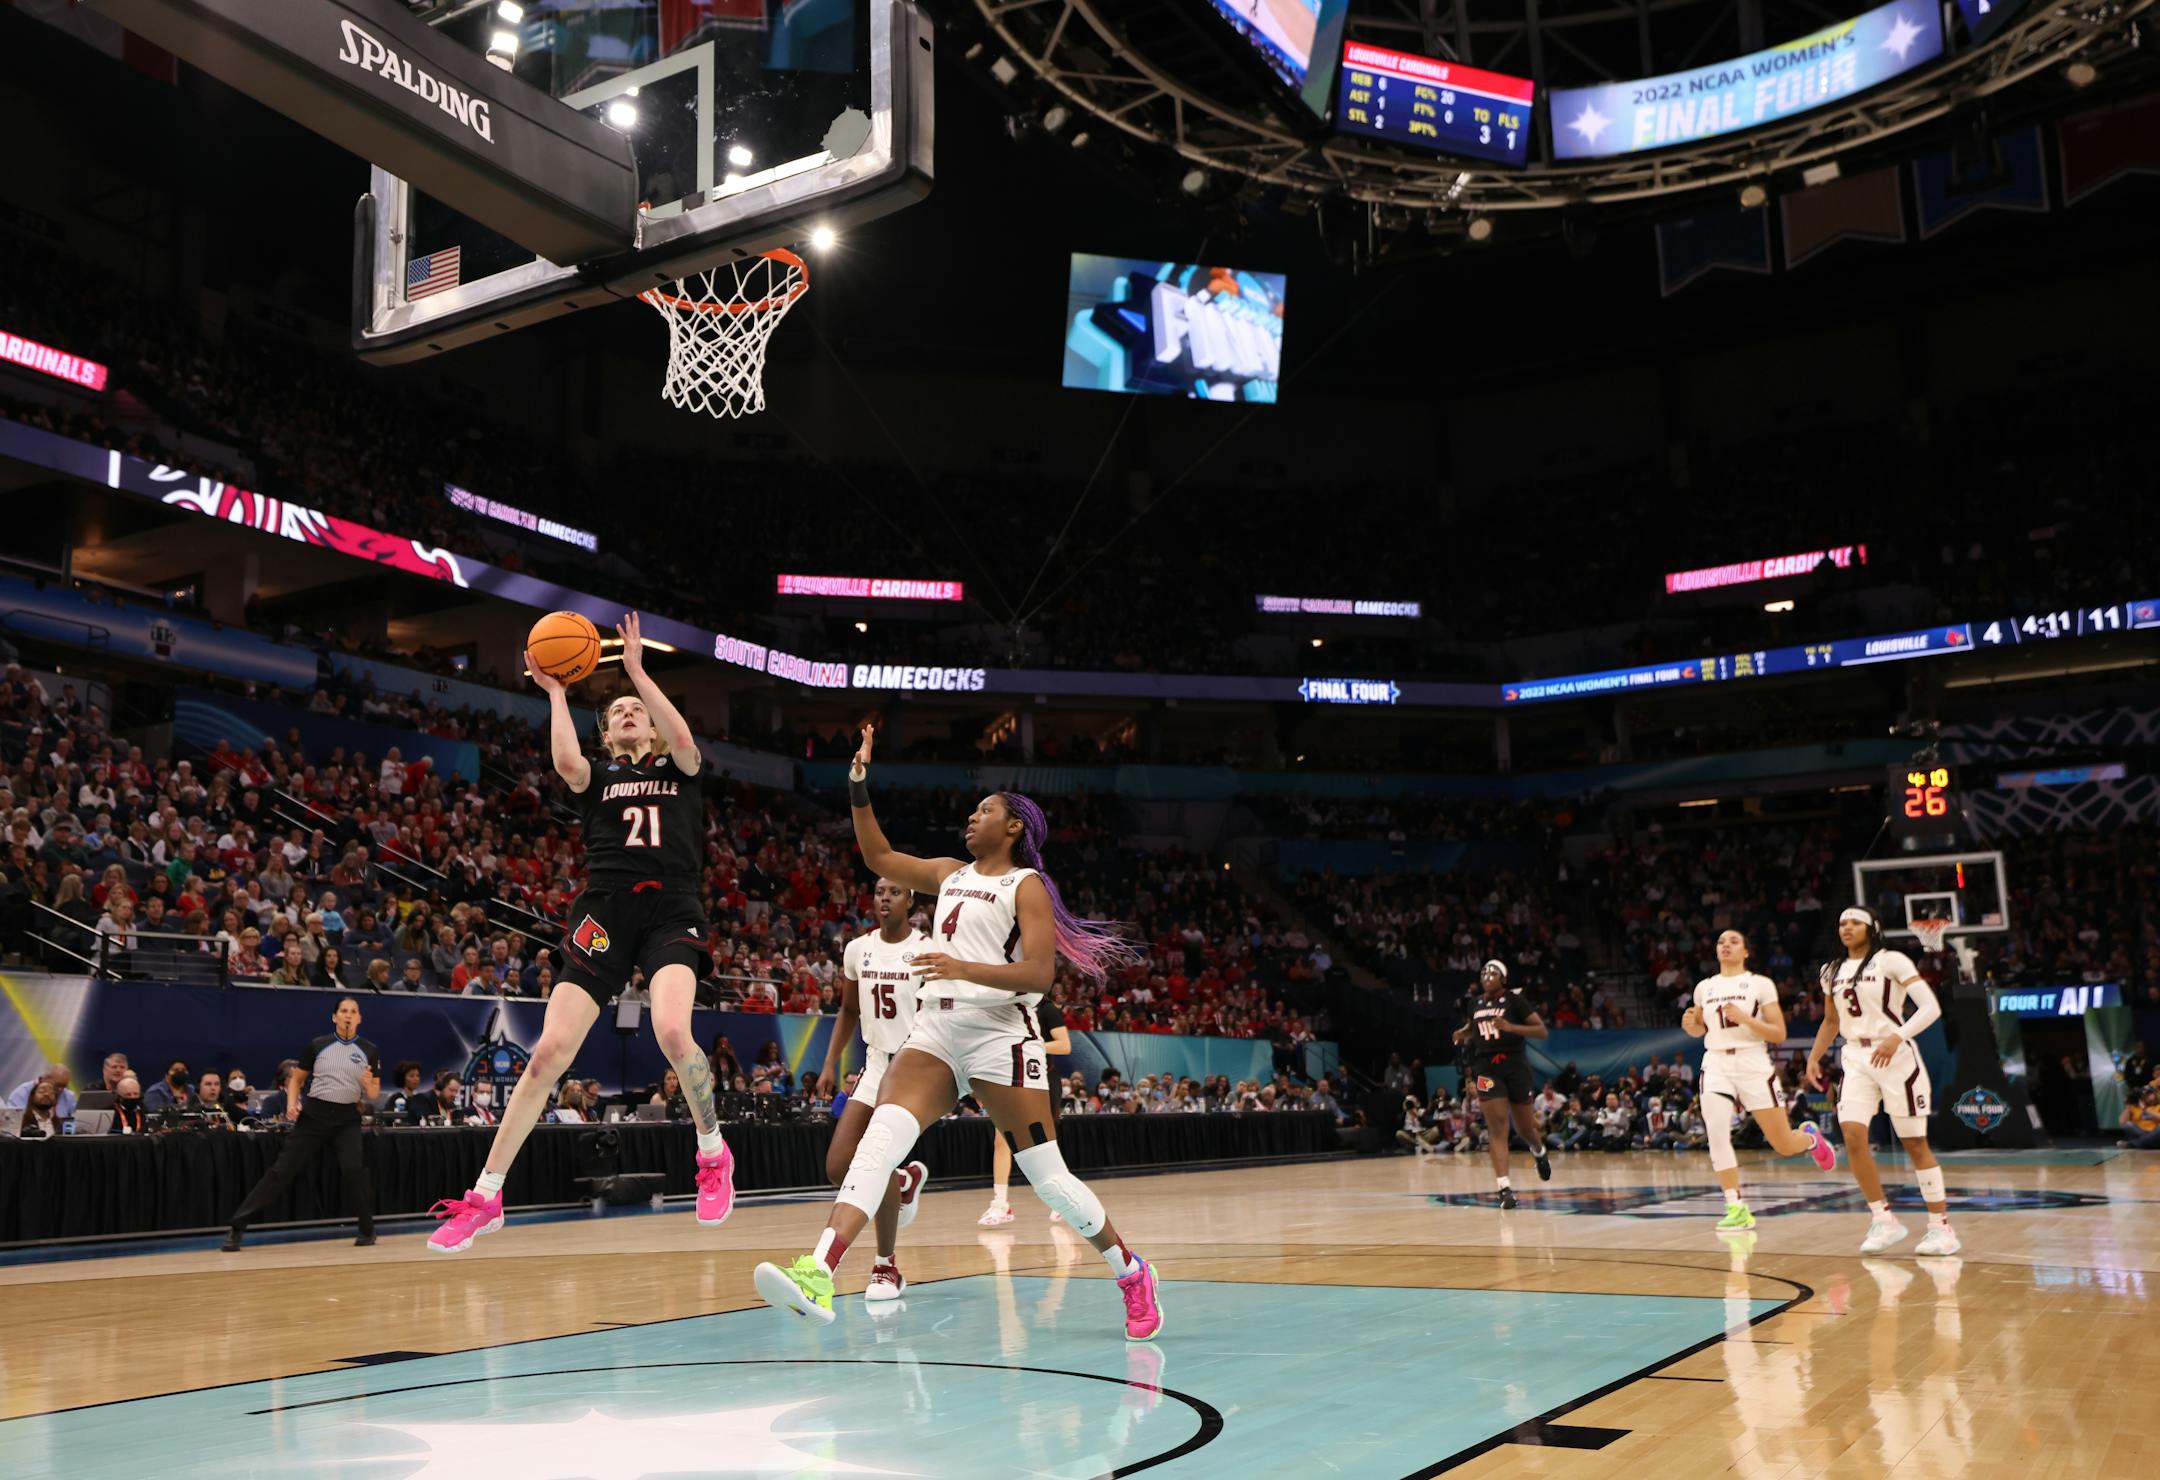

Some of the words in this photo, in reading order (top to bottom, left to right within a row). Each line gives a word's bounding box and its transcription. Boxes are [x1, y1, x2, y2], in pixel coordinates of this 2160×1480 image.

[1347, 46, 1399, 69] LOUISVILLE
[1399, 57, 1450, 80] CARDINALS
[1633, 83, 1682, 105] 2022
[1689, 70, 1745, 94] NCAA
[1751, 30, 1856, 77] WOMEN'S
[339, 20, 494, 143] SPALDING
[1349, 88, 1371, 103] AST
[1378, 96, 1385, 110] 1
[1440, 90, 1455, 105] 20
[1633, 89, 1741, 148] FINAL
[1753, 49, 1858, 120] FOUR
[1348, 108, 1368, 124] STL
[1375, 115, 1384, 129] 2
[1444, 110, 1454, 124] 0
[1473, 107, 1490, 123] TO
[1479, 125, 1491, 144] 3
[1507, 131, 1516, 150] 1
[537, 518, 596, 549] GAMECOCKS
[870, 580, 954, 599] CARDINALS
[1354, 601, 1420, 617] GAMECOCKS
[1982, 621, 2003, 645] 4
[2022, 610, 2071, 635] 4:11
[2088, 605, 2121, 631] 11
[1865, 635, 1928, 655] LOUISVILLE
[715, 634, 766, 671] SOUTH
[767, 650, 848, 688] CAROLINA
[852, 664, 986, 691] GAMECOCKS
[1308, 681, 1349, 700] FINAL
[1351, 683, 1390, 701] FOUR
[1519, 687, 1545, 699] 2022
[1546, 684, 1574, 696] NCAA
[1575, 675, 1628, 692] WOMEN'S
[1629, 672, 1654, 685] FINAL
[1655, 668, 1680, 682] FOUR
[601, 780, 679, 801] LOUISVILLE
[1904, 787, 1947, 817] 26
[622, 804, 662, 848] 21
[945, 888, 963, 897] SOUTH
[963, 889, 996, 904] CAROLINA
[942, 901, 965, 942] 4
[861, 970, 878, 979] SOUTH
[880, 971, 910, 981] CAROLINA
[871, 983, 897, 1019] 15
[1843, 987, 1862, 1018] 3
[2000, 995, 2037, 1011] FOUR
[2041, 994, 2056, 1009] IT
[1478, 1021, 1500, 1040] 44
[1957, 1104, 1981, 1114] FINAL
[1982, 1104, 2004, 1114] FOUR
